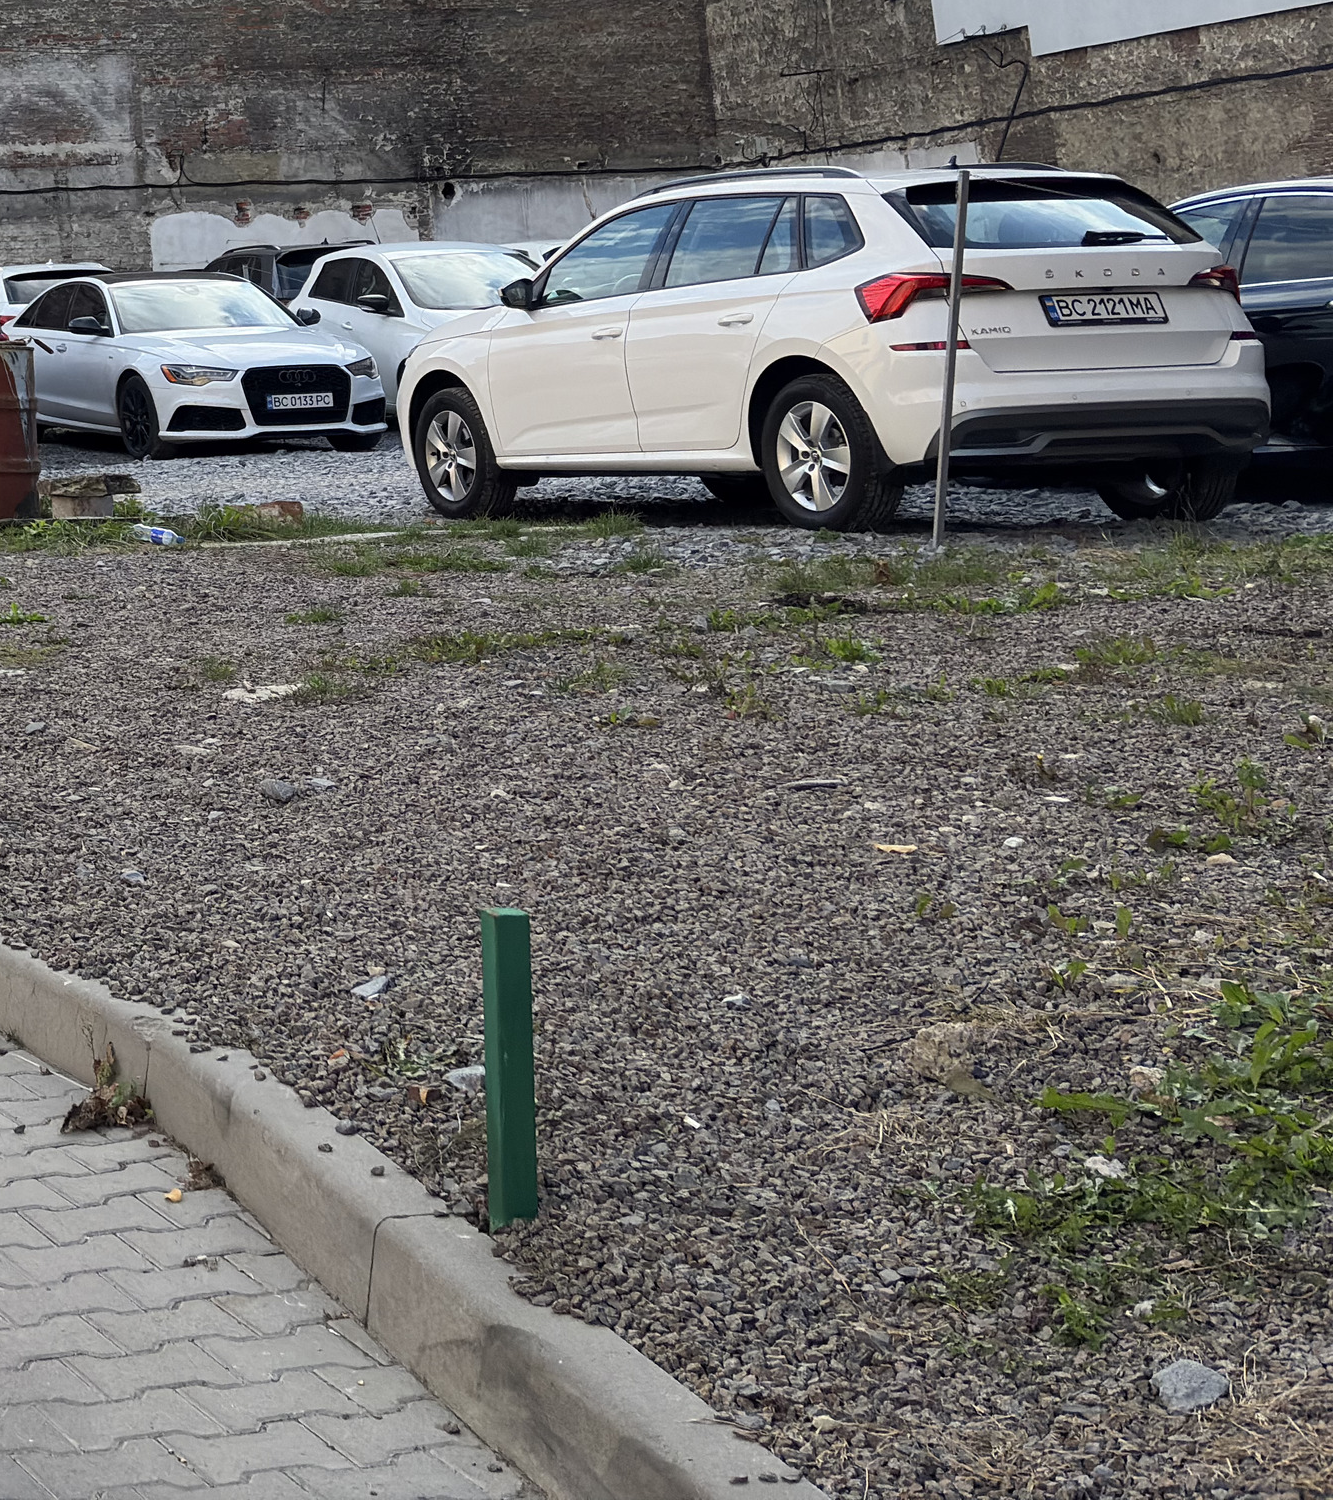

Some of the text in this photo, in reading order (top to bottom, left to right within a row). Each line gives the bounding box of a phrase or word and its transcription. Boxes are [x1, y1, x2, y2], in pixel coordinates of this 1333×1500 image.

[1056, 297, 1158, 317] BC 2121 MA
[971, 326, 1011, 336] KAMIQ
[273, 394, 331, 407] BC 0133 PC
